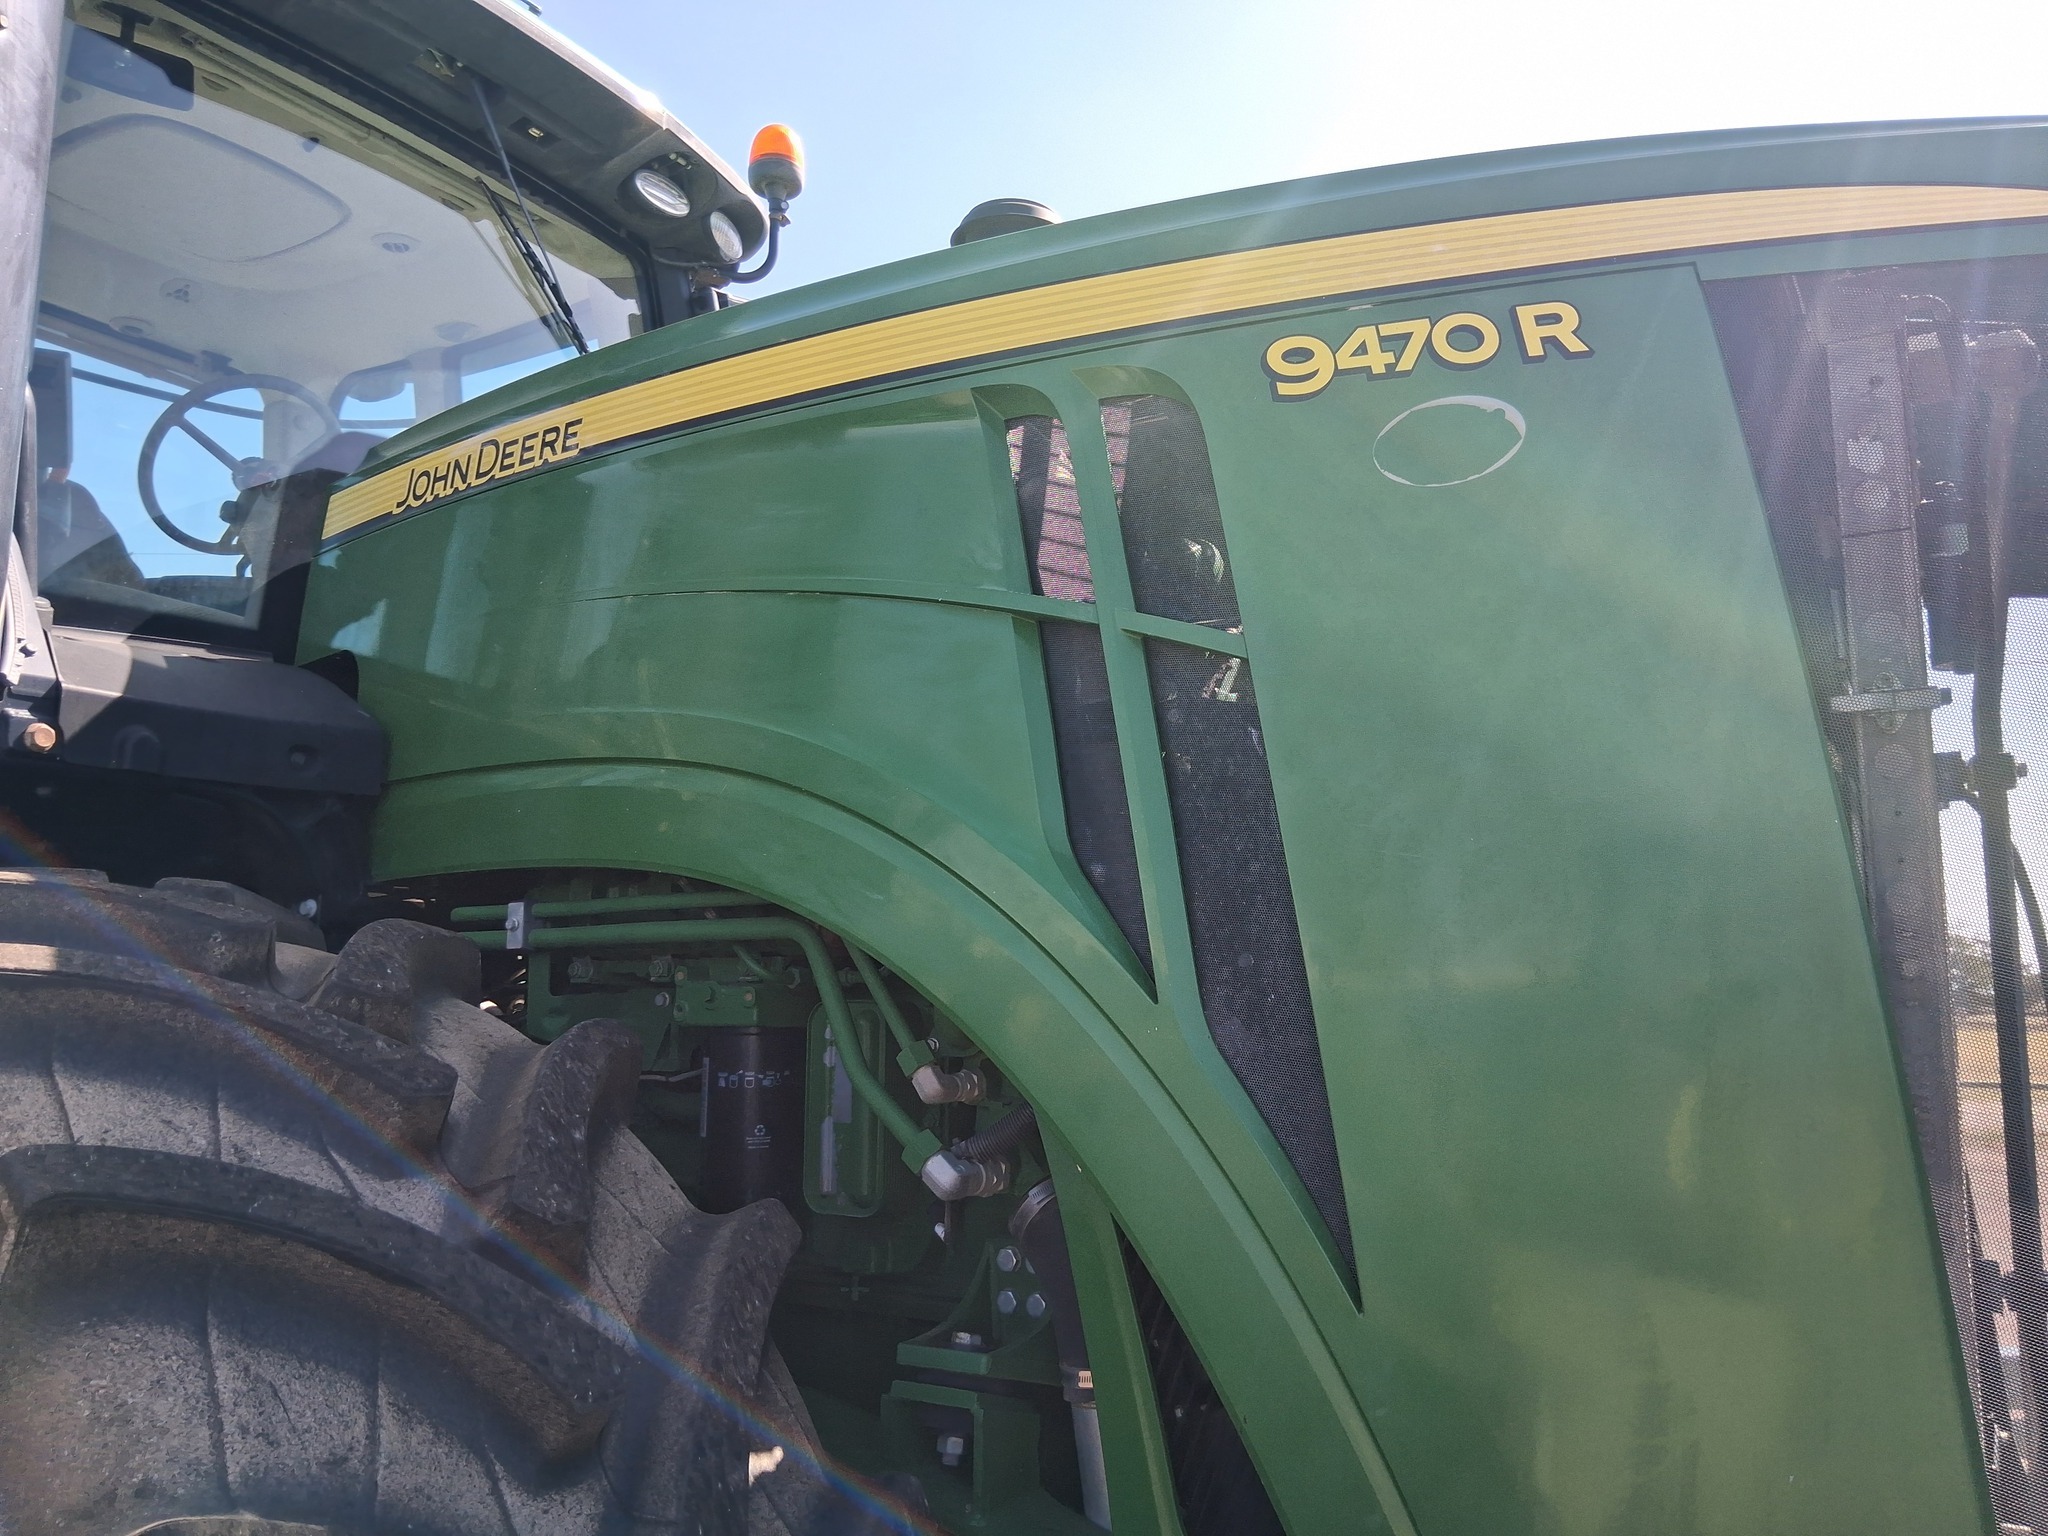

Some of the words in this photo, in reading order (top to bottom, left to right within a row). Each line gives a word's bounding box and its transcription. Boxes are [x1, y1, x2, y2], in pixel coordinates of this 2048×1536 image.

[1263, 310, 1501, 400] 9470
[1510, 300, 1593, 363] R
[394, 452, 473, 510] JOHN
[474, 416, 584, 481] DEERE
